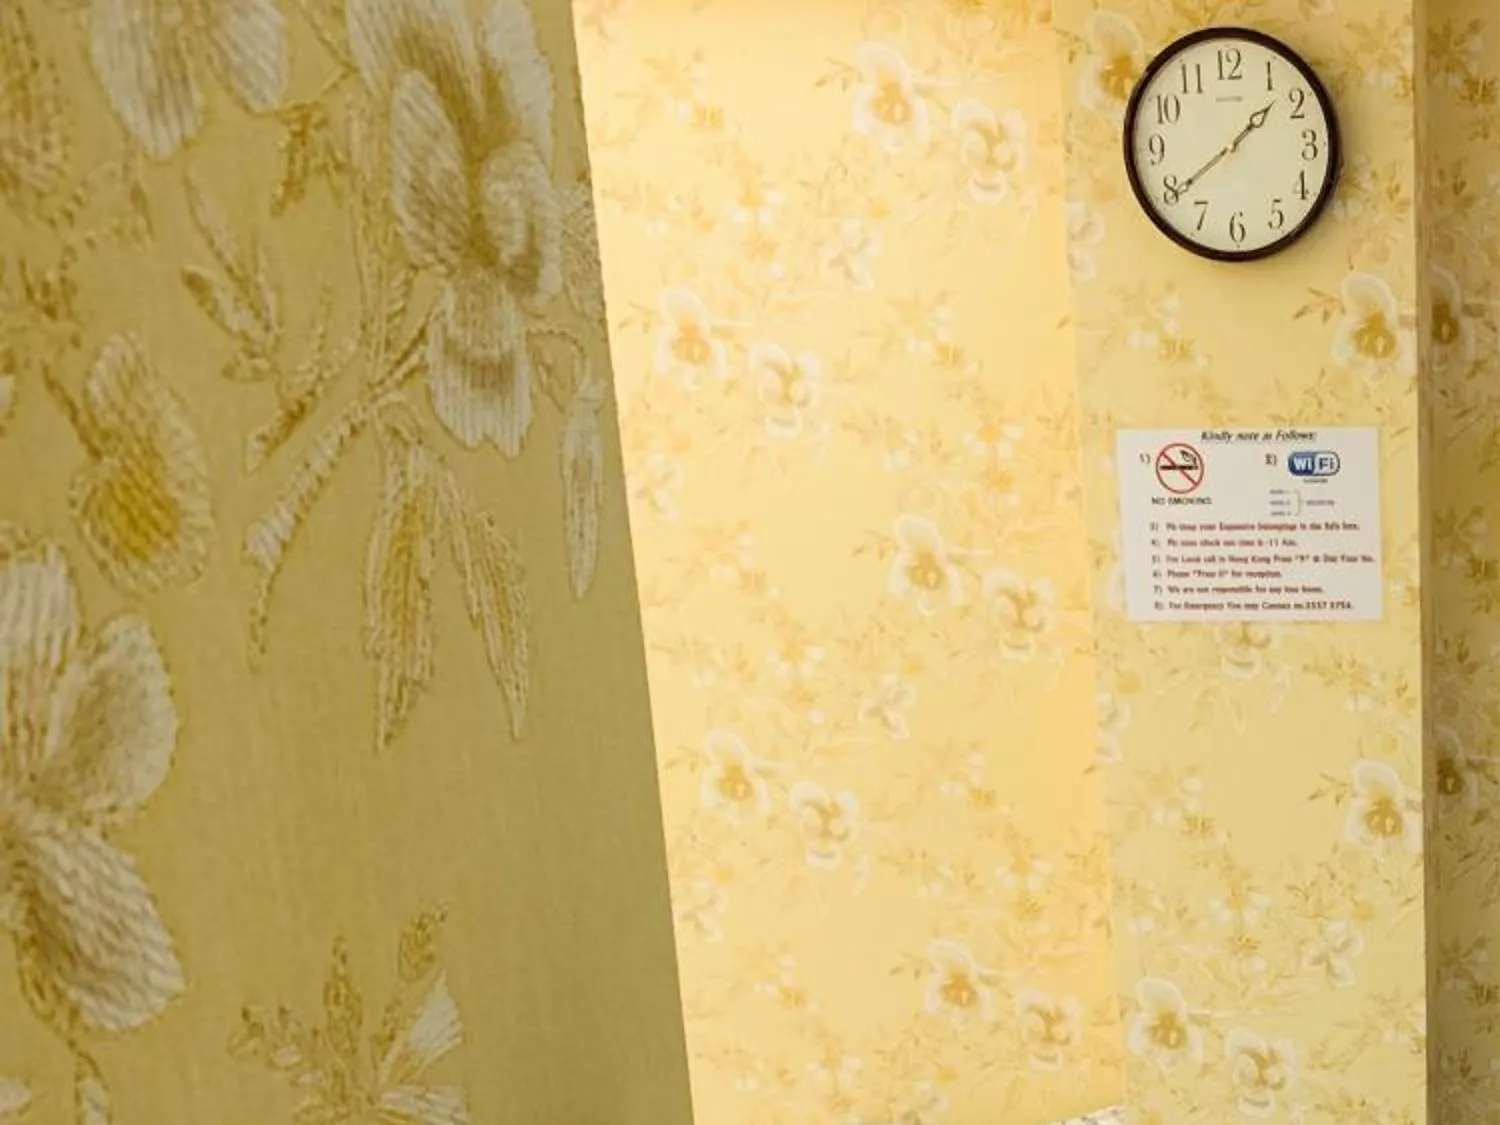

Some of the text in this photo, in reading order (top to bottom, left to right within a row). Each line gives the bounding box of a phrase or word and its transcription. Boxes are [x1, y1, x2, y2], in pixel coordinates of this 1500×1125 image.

[1181, 63, 1204, 95] 11
[1216, 48, 1243, 81] 12
[1265, 61, 1274, 92] 1
[1156, 93, 1181, 125] 10
[1289, 88, 1305, 119] 2
[1148, 134, 1165, 166] 9
[1301, 129, 1318, 161] 3
[1163, 175, 1179, 207] 8
[1293, 170, 1309, 201] 4
[1193, 200, 1209, 232] 7
[1229, 211, 1247, 243] 6
[1268, 199, 1285, 230] 5
[1201, 431, 1233, 443] Kindly
[1237, 431, 1260, 441] note
[1151, 497, 1212, 505] NO SMOKING
[1199, 523, 1217, 532] your
[1257, 521, 1298, 533] belongings
[1308, 522, 1323, 531] the
[1199, 538, 1221, 547] check
[1222, 539, 1237, 547] out
[1227, 554, 1249, 565] Hong
[1250, 554, 1272, 565] Kong
[1195, 586, 1210, 594] not
[1211, 585, 1253, 595] responsible
[1254, 584, 1267, 594] for
[1268, 586, 1283, 596] any
[1183, 601, 1225, 612] Emergency
